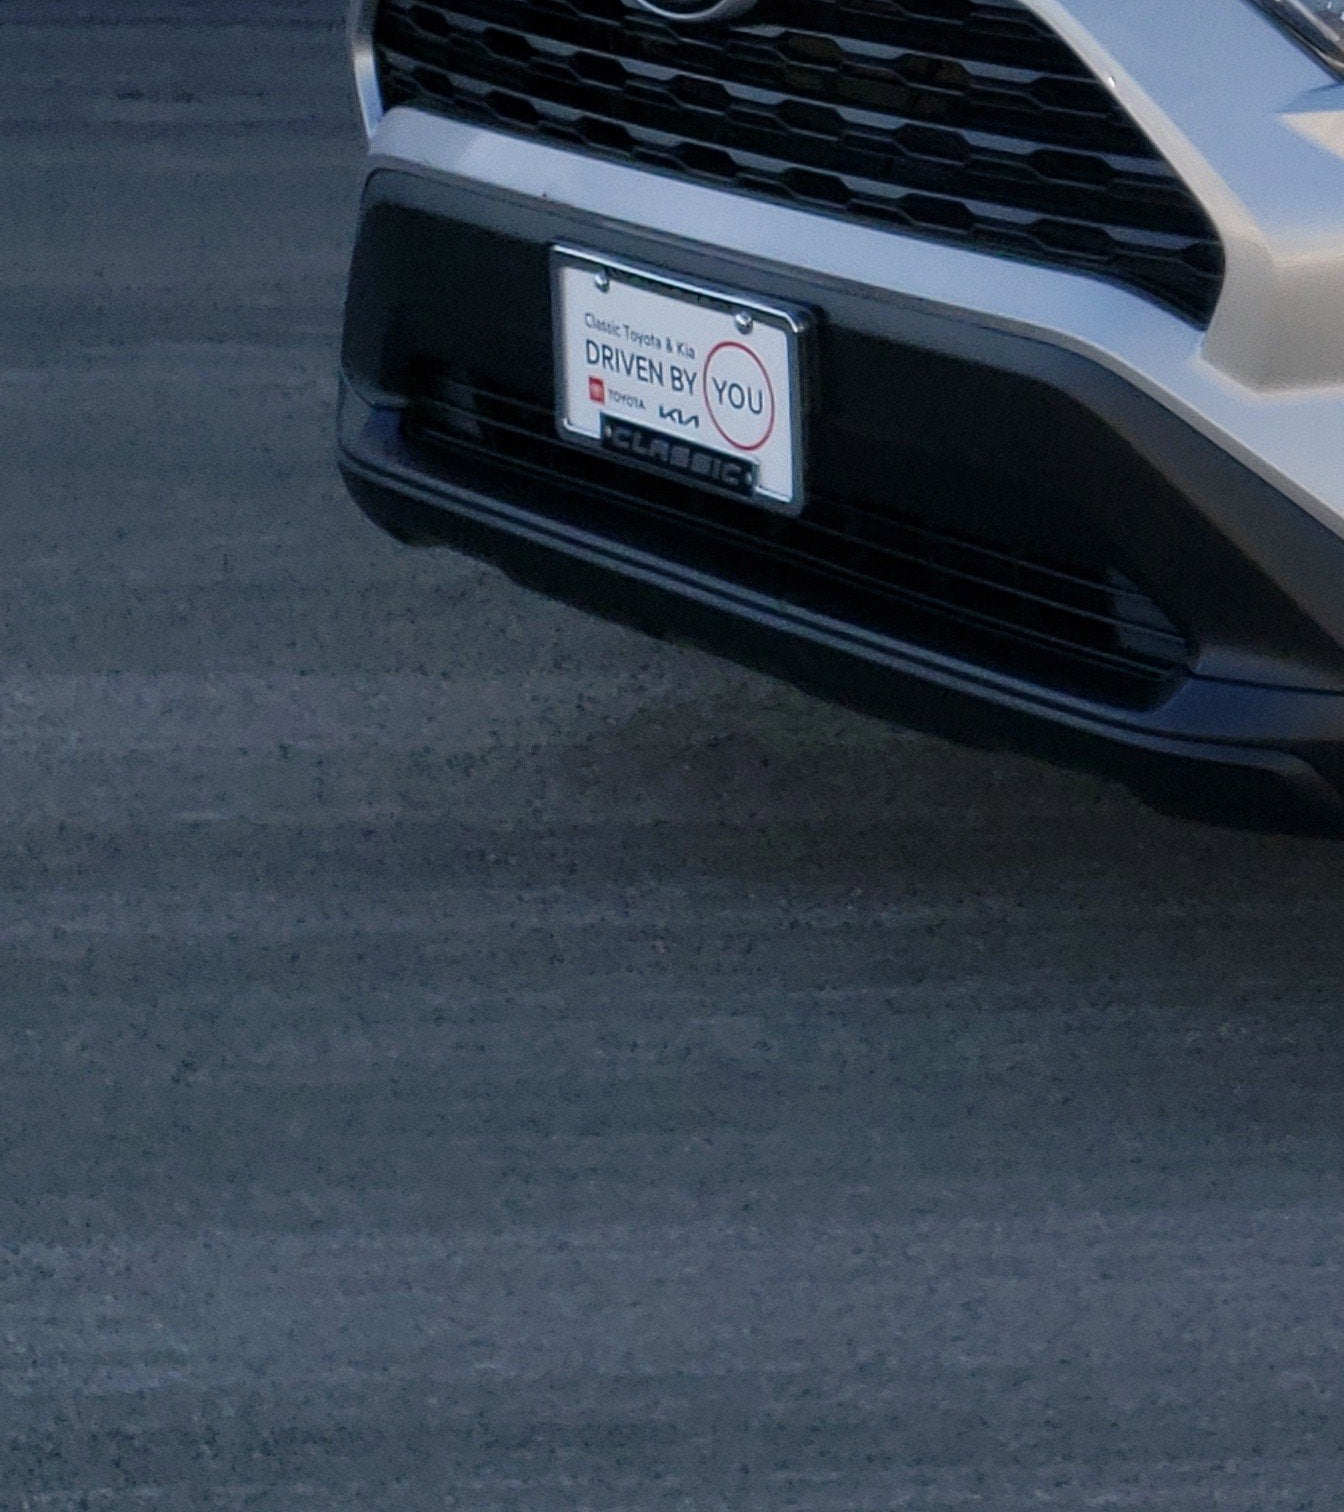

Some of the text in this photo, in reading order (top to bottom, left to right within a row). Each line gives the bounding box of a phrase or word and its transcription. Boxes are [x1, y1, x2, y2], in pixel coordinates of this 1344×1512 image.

[584, 313, 696, 360] Classic Toyota & Kia
[585, 339, 763, 415] DRIVEN BY YOU
[607, 388, 646, 410] TOYOTA
